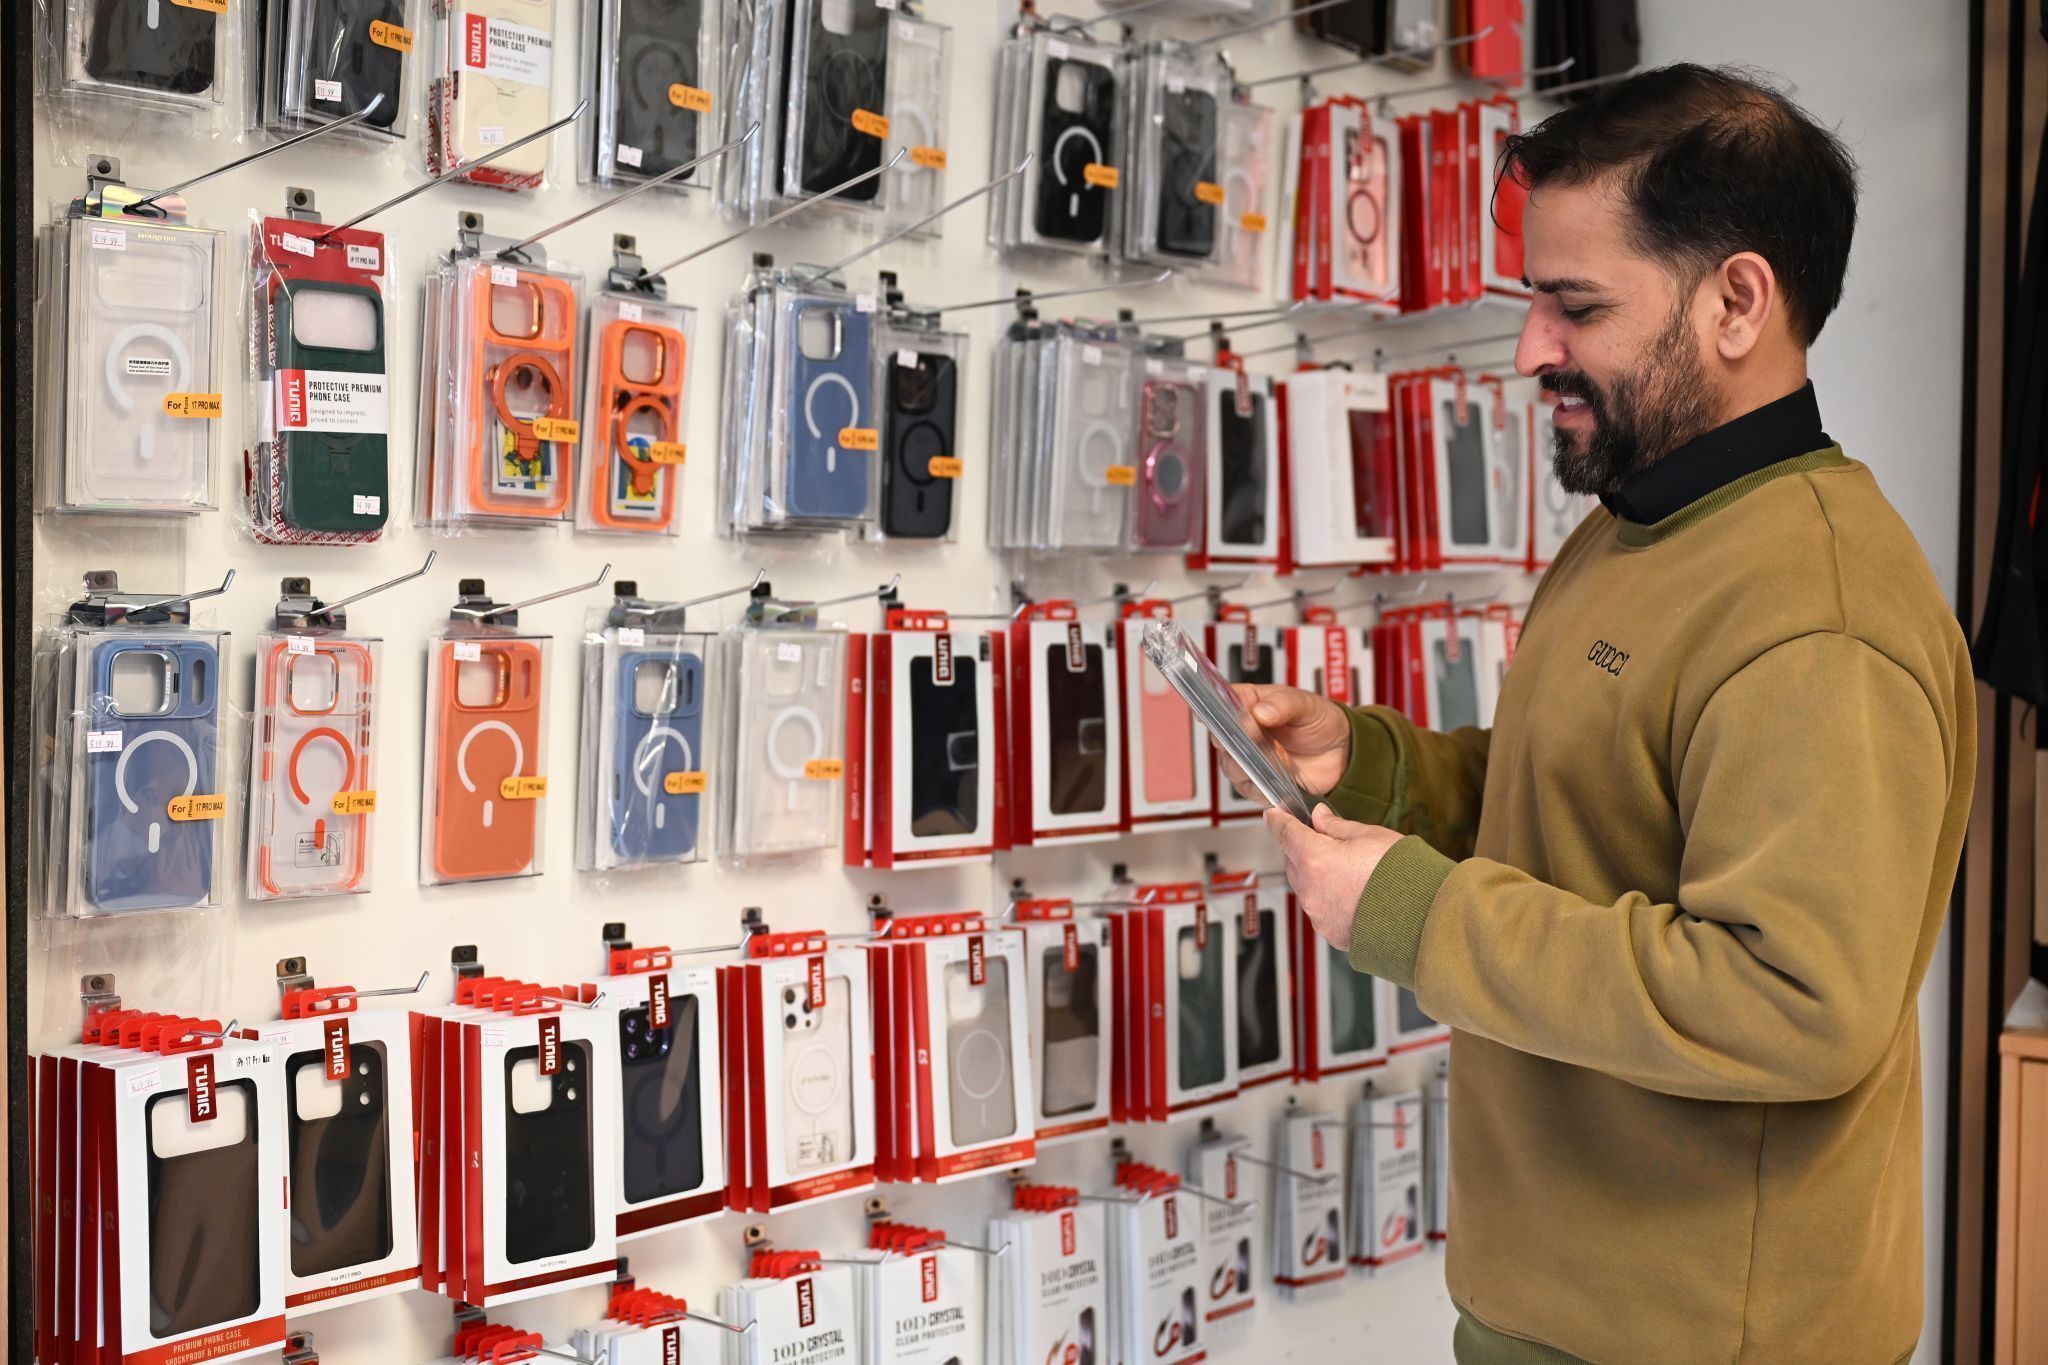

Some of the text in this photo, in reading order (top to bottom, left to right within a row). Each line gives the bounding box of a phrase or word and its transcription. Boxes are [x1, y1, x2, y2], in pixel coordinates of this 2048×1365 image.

[372, 27, 383, 37] For
[471, 22, 482, 63] TUNIQ
[489, 27, 526, 43] PROTECTIVE
[489, 37, 526, 53] PHONE CASE
[95, 234, 117, 245] £1999
[309, 382, 381, 394] PROTECTIVE PREMIUM
[309, 392, 351, 403] PHONE CASE
[167, 401, 182, 410] For
[192, 401, 197, 409] 17
[198, 401, 208, 410] PRO
[209, 401, 220, 410] MAX
[289, 379, 301, 423] TUNIQ
[311, 408, 335, 416] Designed
[310, 416, 327, 424] priced
[1587, 639, 1630, 677] GUCCI
[504, 784, 515, 792] For
[172, 804, 186, 813] For
[196, 802, 201, 811] 17
[201, 802, 212, 811] PRO
[212, 801, 224, 810] MAX
[334, 801, 345, 809] For
[972, 943, 983, 982] TUNIQ
[812, 963, 823, 1005] TUNIQ
[654, 982, 667, 1025] TUNIQ
[332, 1027, 346, 1075] TUNIQ
[545, 1025, 557, 1071] TUNIQ
[245, 1056, 251, 1067] 17
[195, 1064, 210, 1117] TUNIQ
[351, 1271, 362, 1279] PRO
[303, 1278, 387, 1302] SMARTPHONE PROTECTIVE COVER
[801, 1282, 813, 1324] TUNIQ
[896, 1306, 964, 1334] 10D CRYSTAL
[165, 1338, 251, 1365] SHOCKPROOF & PROTECTIVE
[173, 1329, 242, 1354] PREMIUM PHONE CASE
[773, 1330, 844, 1362] 10D CRYSTAL
